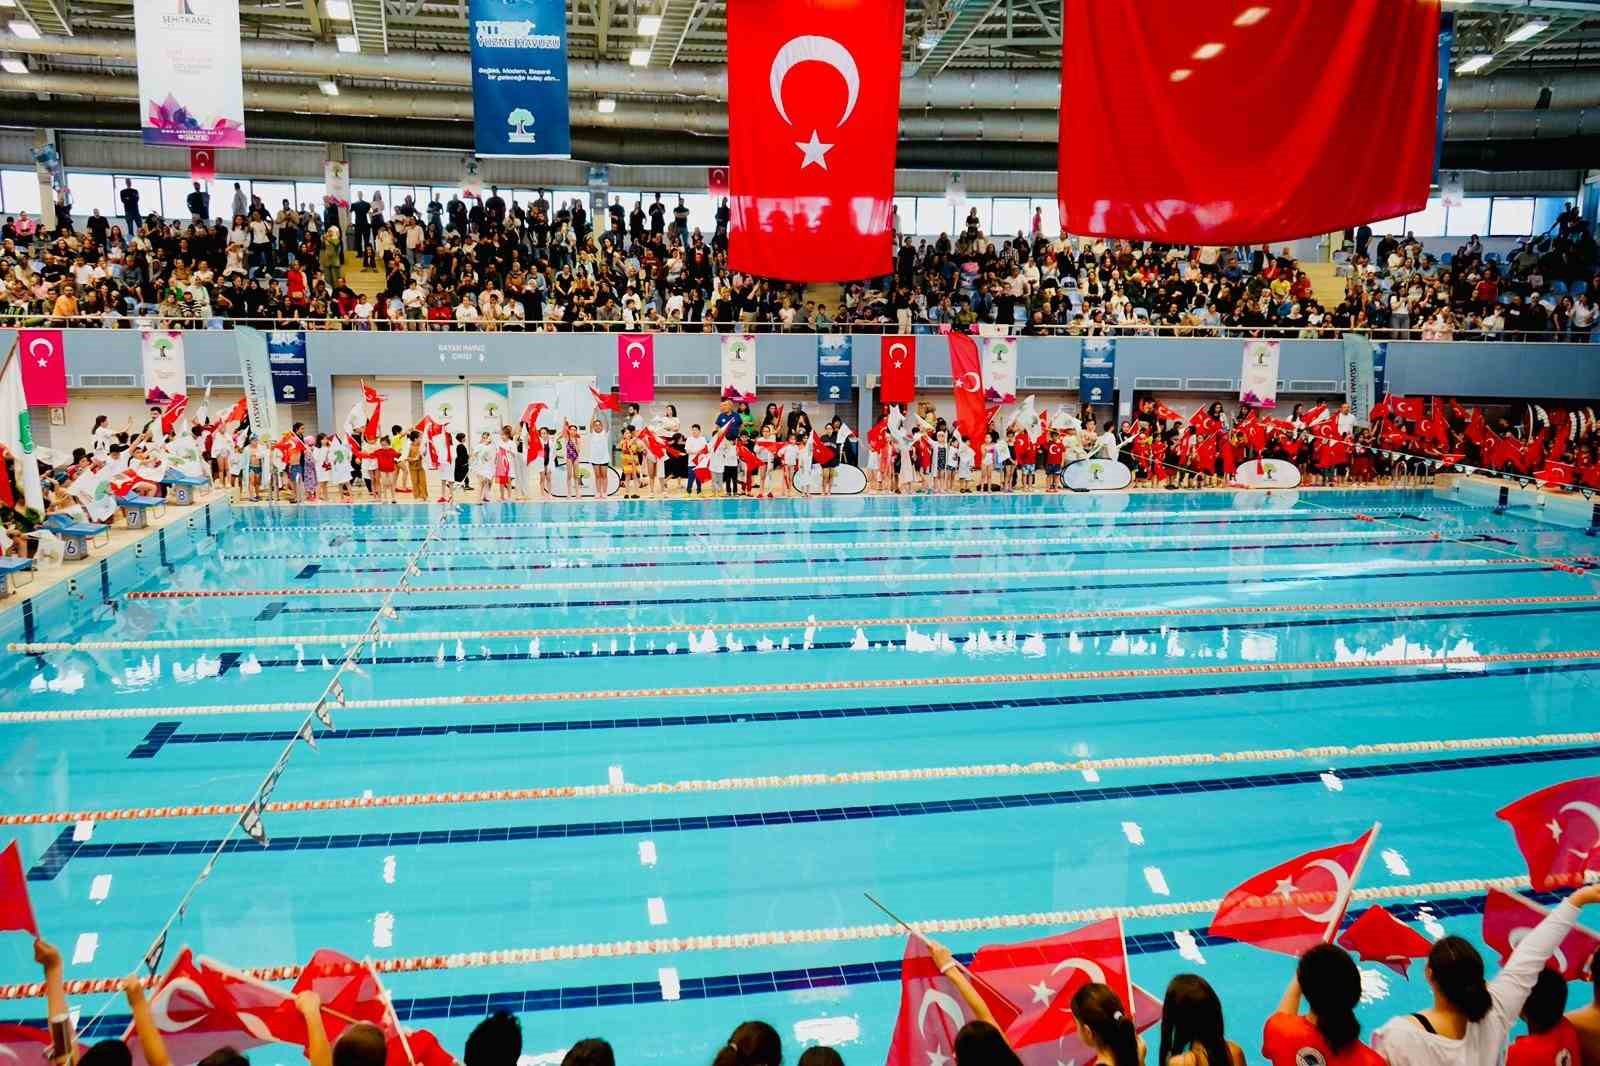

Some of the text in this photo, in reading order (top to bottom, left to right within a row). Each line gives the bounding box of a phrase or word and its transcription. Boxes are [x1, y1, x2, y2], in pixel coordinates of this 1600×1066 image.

[177, 489, 186, 500] 8
[128, 512, 138, 524] 7
[67, 541, 76, 554] 6
